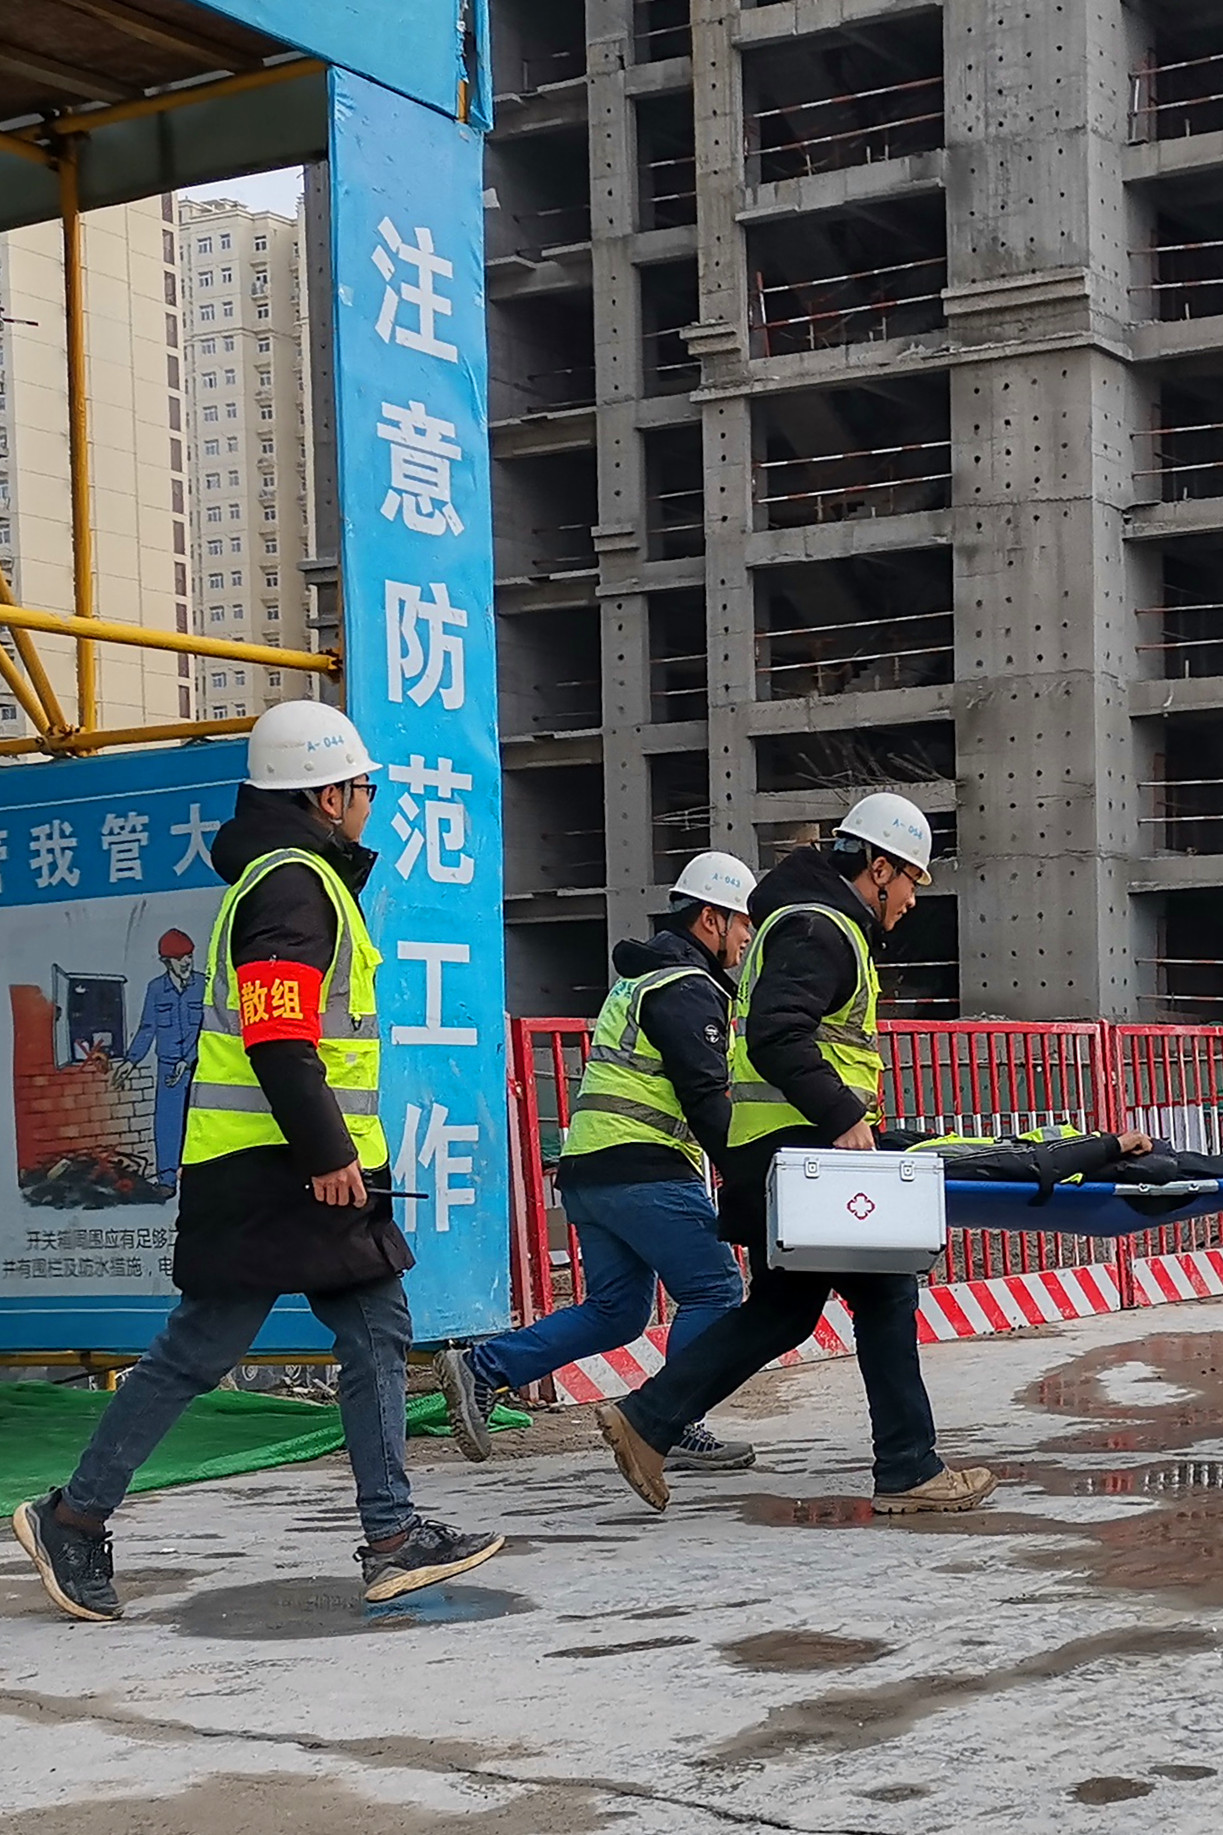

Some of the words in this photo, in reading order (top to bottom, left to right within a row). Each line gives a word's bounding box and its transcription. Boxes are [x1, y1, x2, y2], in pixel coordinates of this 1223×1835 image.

[371, 215, 479, 1232] 注意防范工作
[0, 803, 221, 894] 我管大
[241, 978, 304, 1026] 散组
